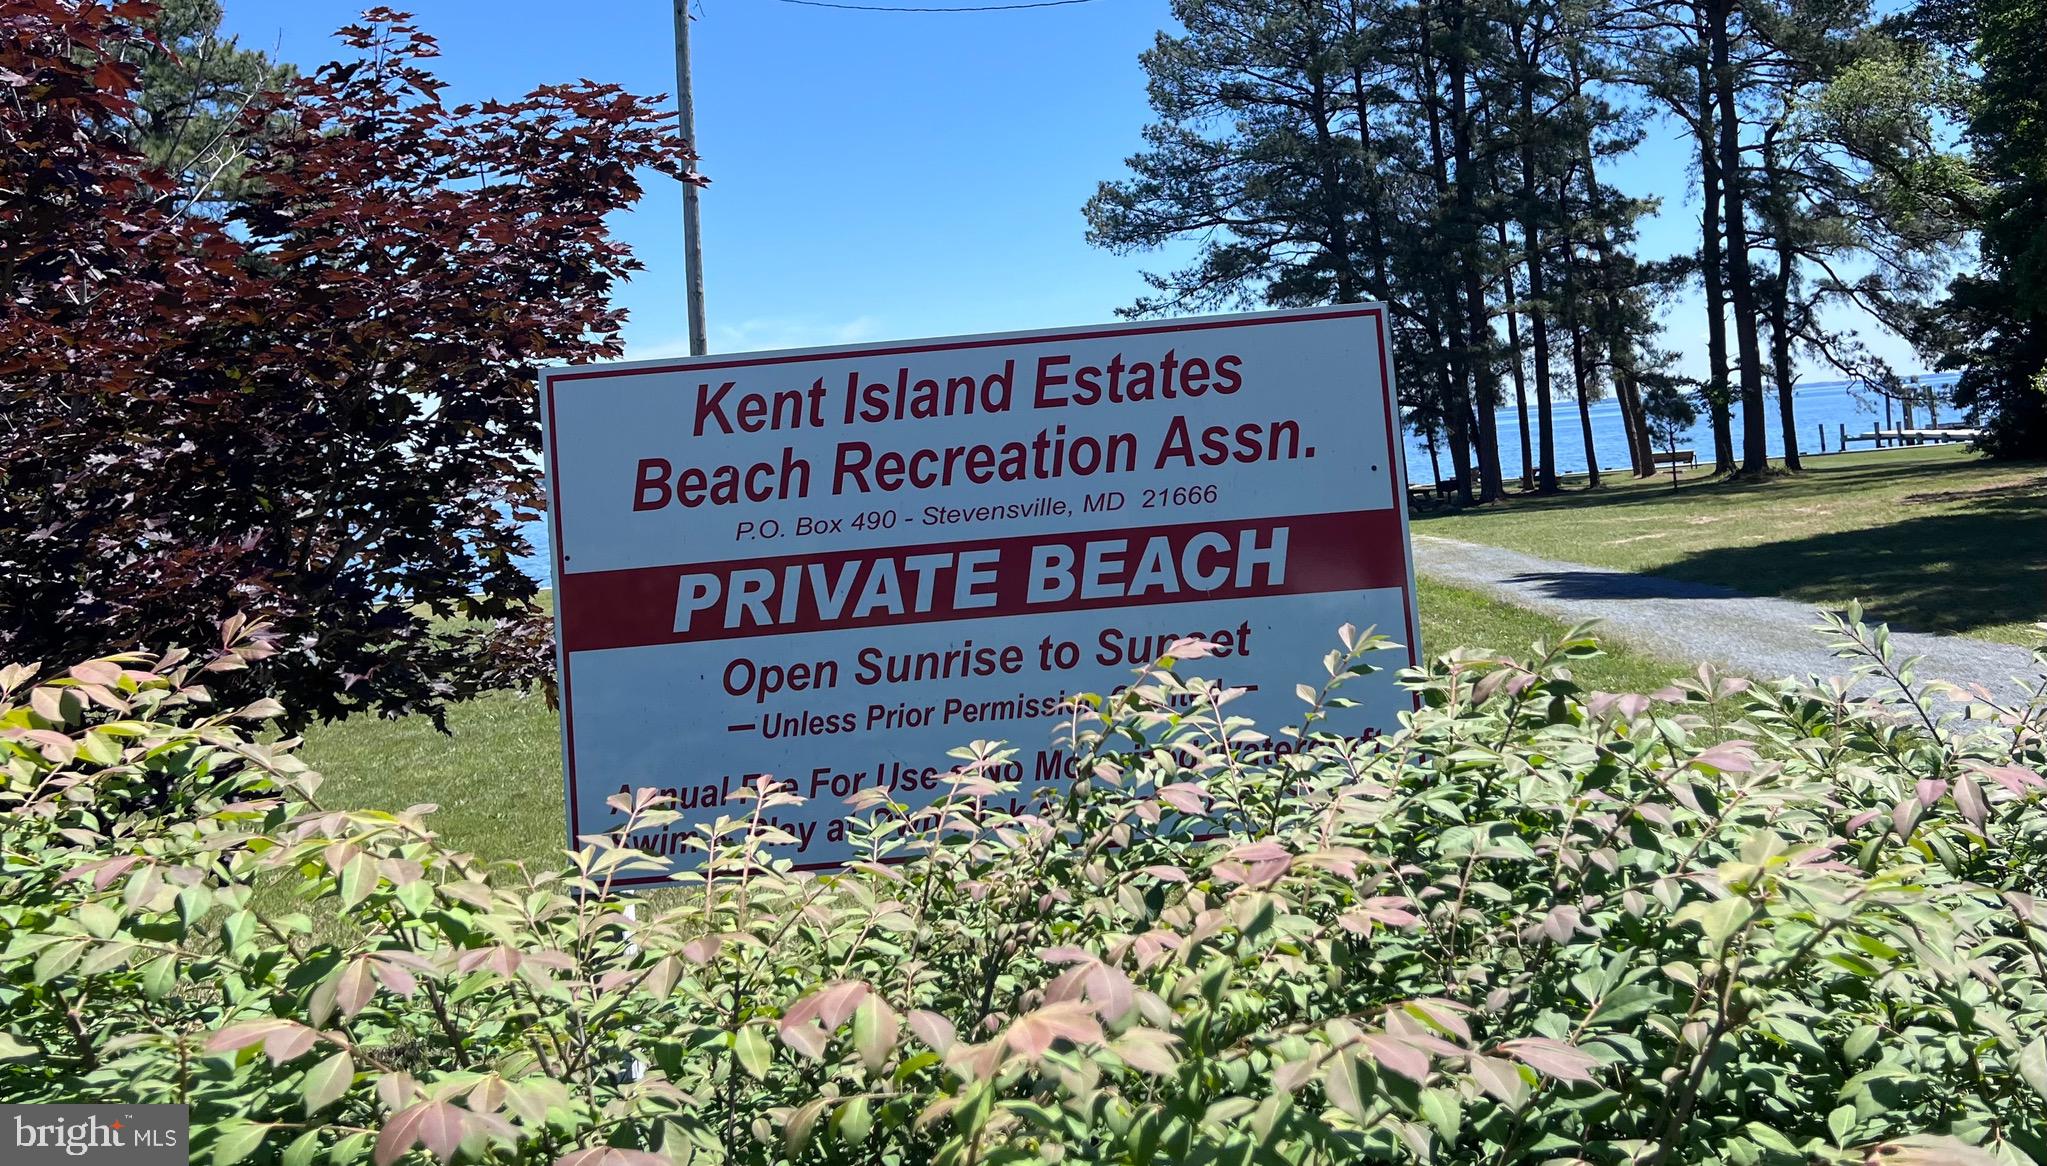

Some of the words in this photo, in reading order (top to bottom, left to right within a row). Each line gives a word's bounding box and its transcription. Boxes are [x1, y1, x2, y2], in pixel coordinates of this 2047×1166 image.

[693, 376, 827, 437] Kent
[843, 361, 1015, 425] Island
[1033, 348, 1243, 409] Estates
[632, 446, 811, 512] Beach
[831, 419, 1138, 499] Recreation
[1153, 415, 1316, 470] Assn.
[735, 519, 785, 542] P.O.
[795, 516, 843, 537] Box
[850, 509, 897, 531] 490
[922, 496, 1073, 526] Stevensville,
[1083, 491, 1125, 513] MD
[1141, 484, 1218, 509] 21666
[672, 548, 1001, 633] PRIVATE
[1026, 526, 1290, 604] BEACH
[722, 657, 839, 704] Open
[854, 639, 1024, 686] Sunrise
[1038, 634, 1080, 672] to
[1095, 619, 1252, 667] Sunet
[866, 702, 936, 731] Prior
[610, 776, 728, 815] Anual
[740, 774, 799, 805] Fe
[809, 767, 867, 799] For
[876, 761, 939, 794] Use
[1211, 727, 1383, 767] atercft
